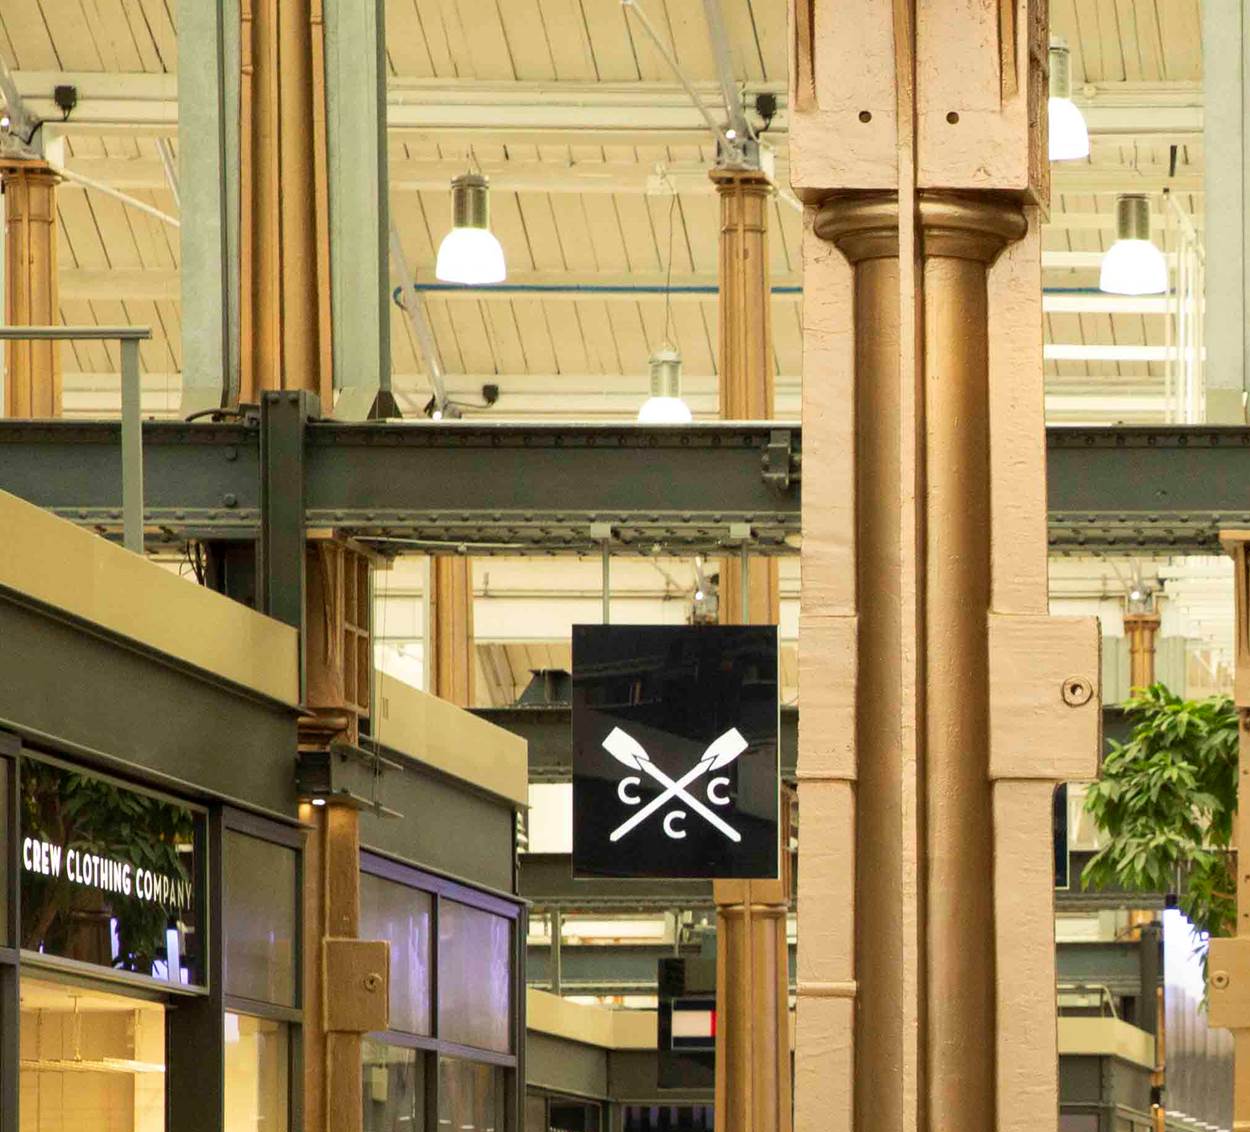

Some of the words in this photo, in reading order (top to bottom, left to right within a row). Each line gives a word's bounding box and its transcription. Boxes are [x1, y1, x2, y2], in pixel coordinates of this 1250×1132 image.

[617, 776, 641, 805] C
[706, 776, 731, 806] C
[663, 810, 687, 839] C
[23, 837, 62, 878] CREW
[66, 849, 132, 896] CLOTHING
[135, 867, 192, 911] COMPANY
